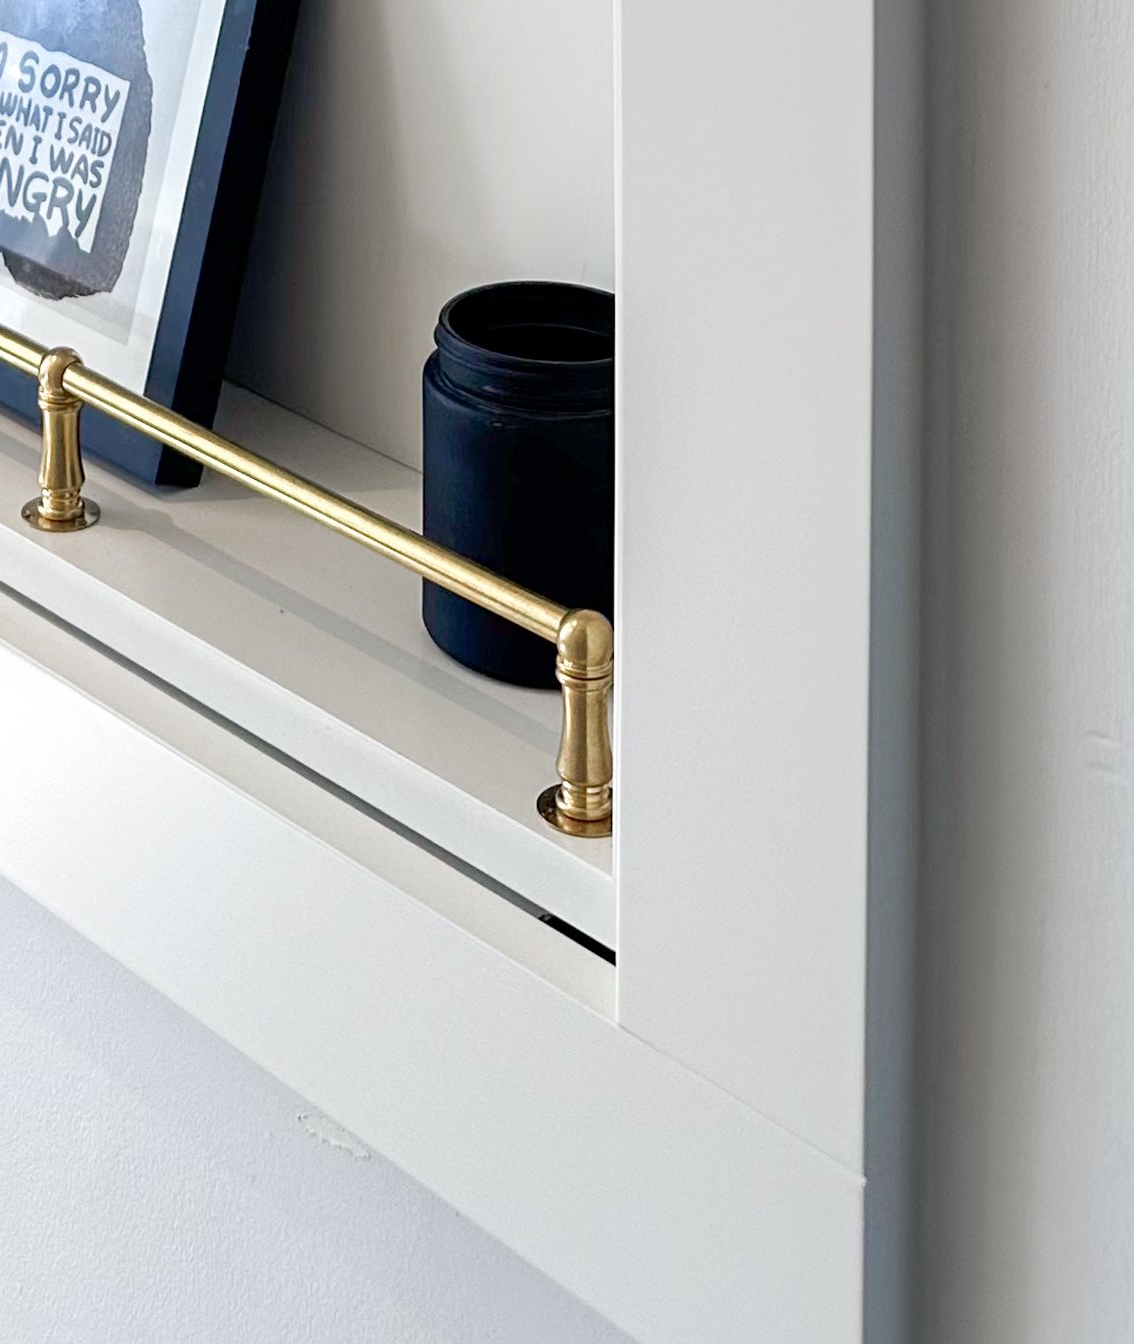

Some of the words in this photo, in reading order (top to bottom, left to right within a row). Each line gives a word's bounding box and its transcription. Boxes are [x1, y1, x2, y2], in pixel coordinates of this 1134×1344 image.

[18, 50, 120, 123] SORRY
[0, 91, 53, 133] WHAT
[54, 112, 67, 140] I
[68, 116, 112, 158] SAID
[29, 135, 42, 164] I
[49, 143, 104, 188] WAS
